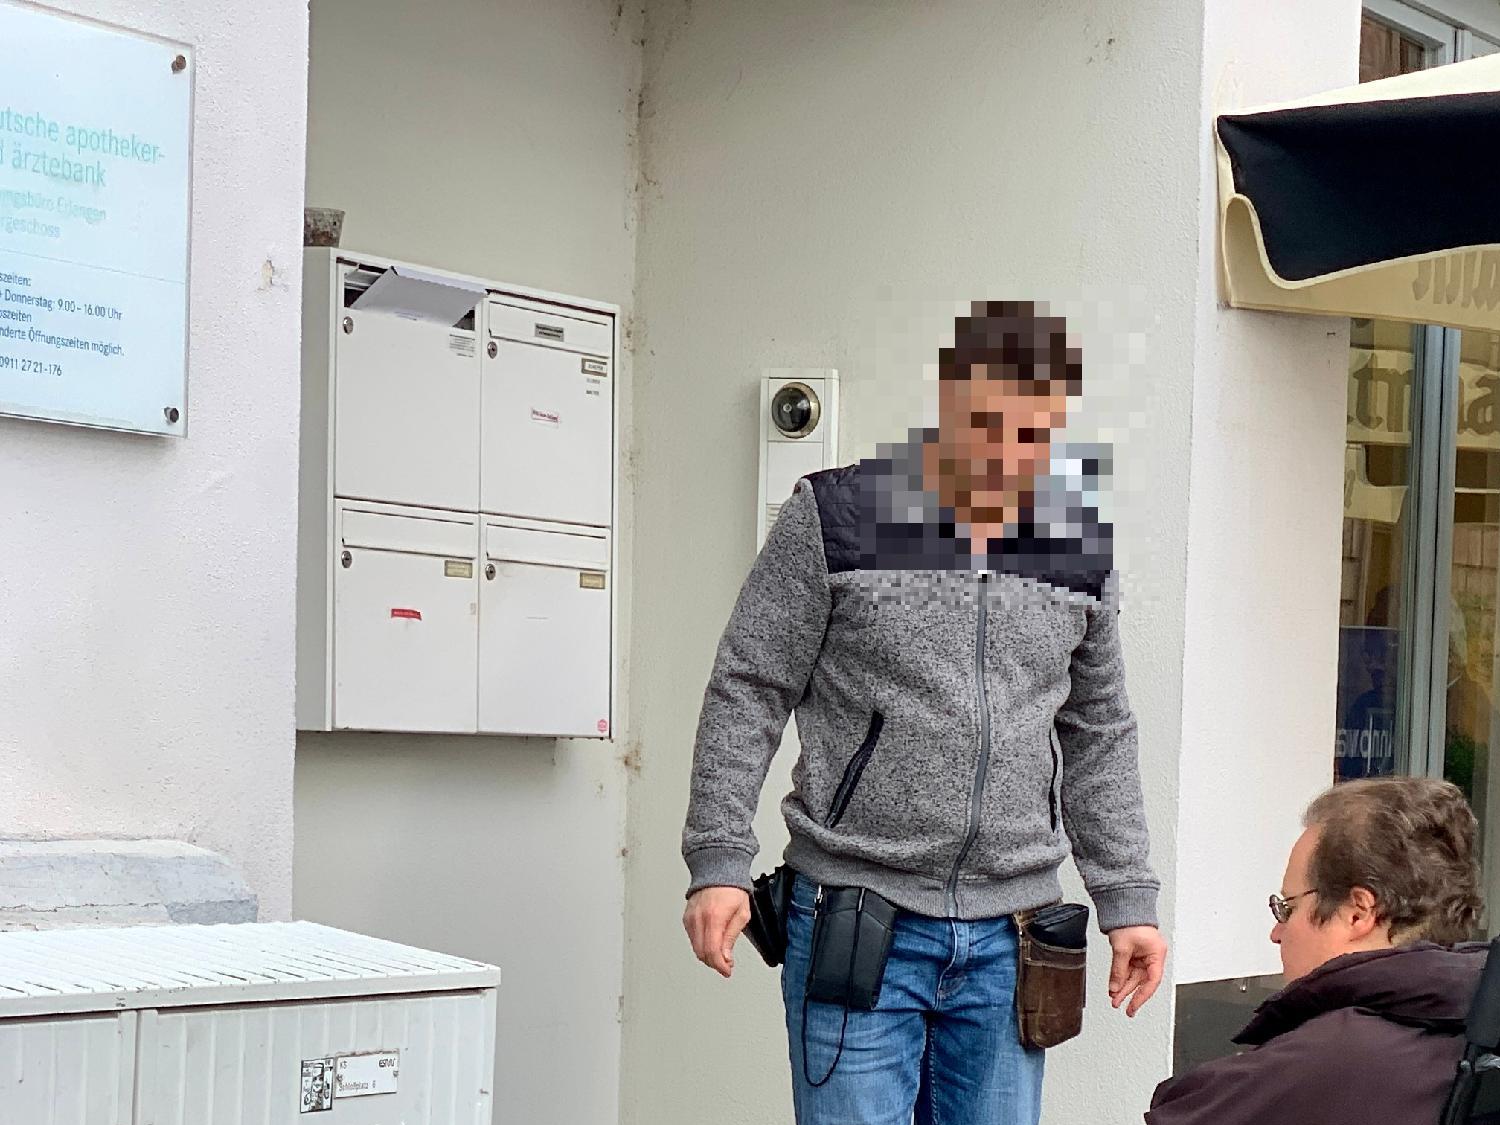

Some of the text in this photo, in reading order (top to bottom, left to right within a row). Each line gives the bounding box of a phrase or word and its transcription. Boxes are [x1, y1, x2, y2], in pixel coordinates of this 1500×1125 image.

[66, 125, 165, 164] apotheker-
[12, 142, 106, 187] ärztebank
[108, 308, 122, 320] Uhr
[29, 327, 90, 350] Öffnungszeiten
